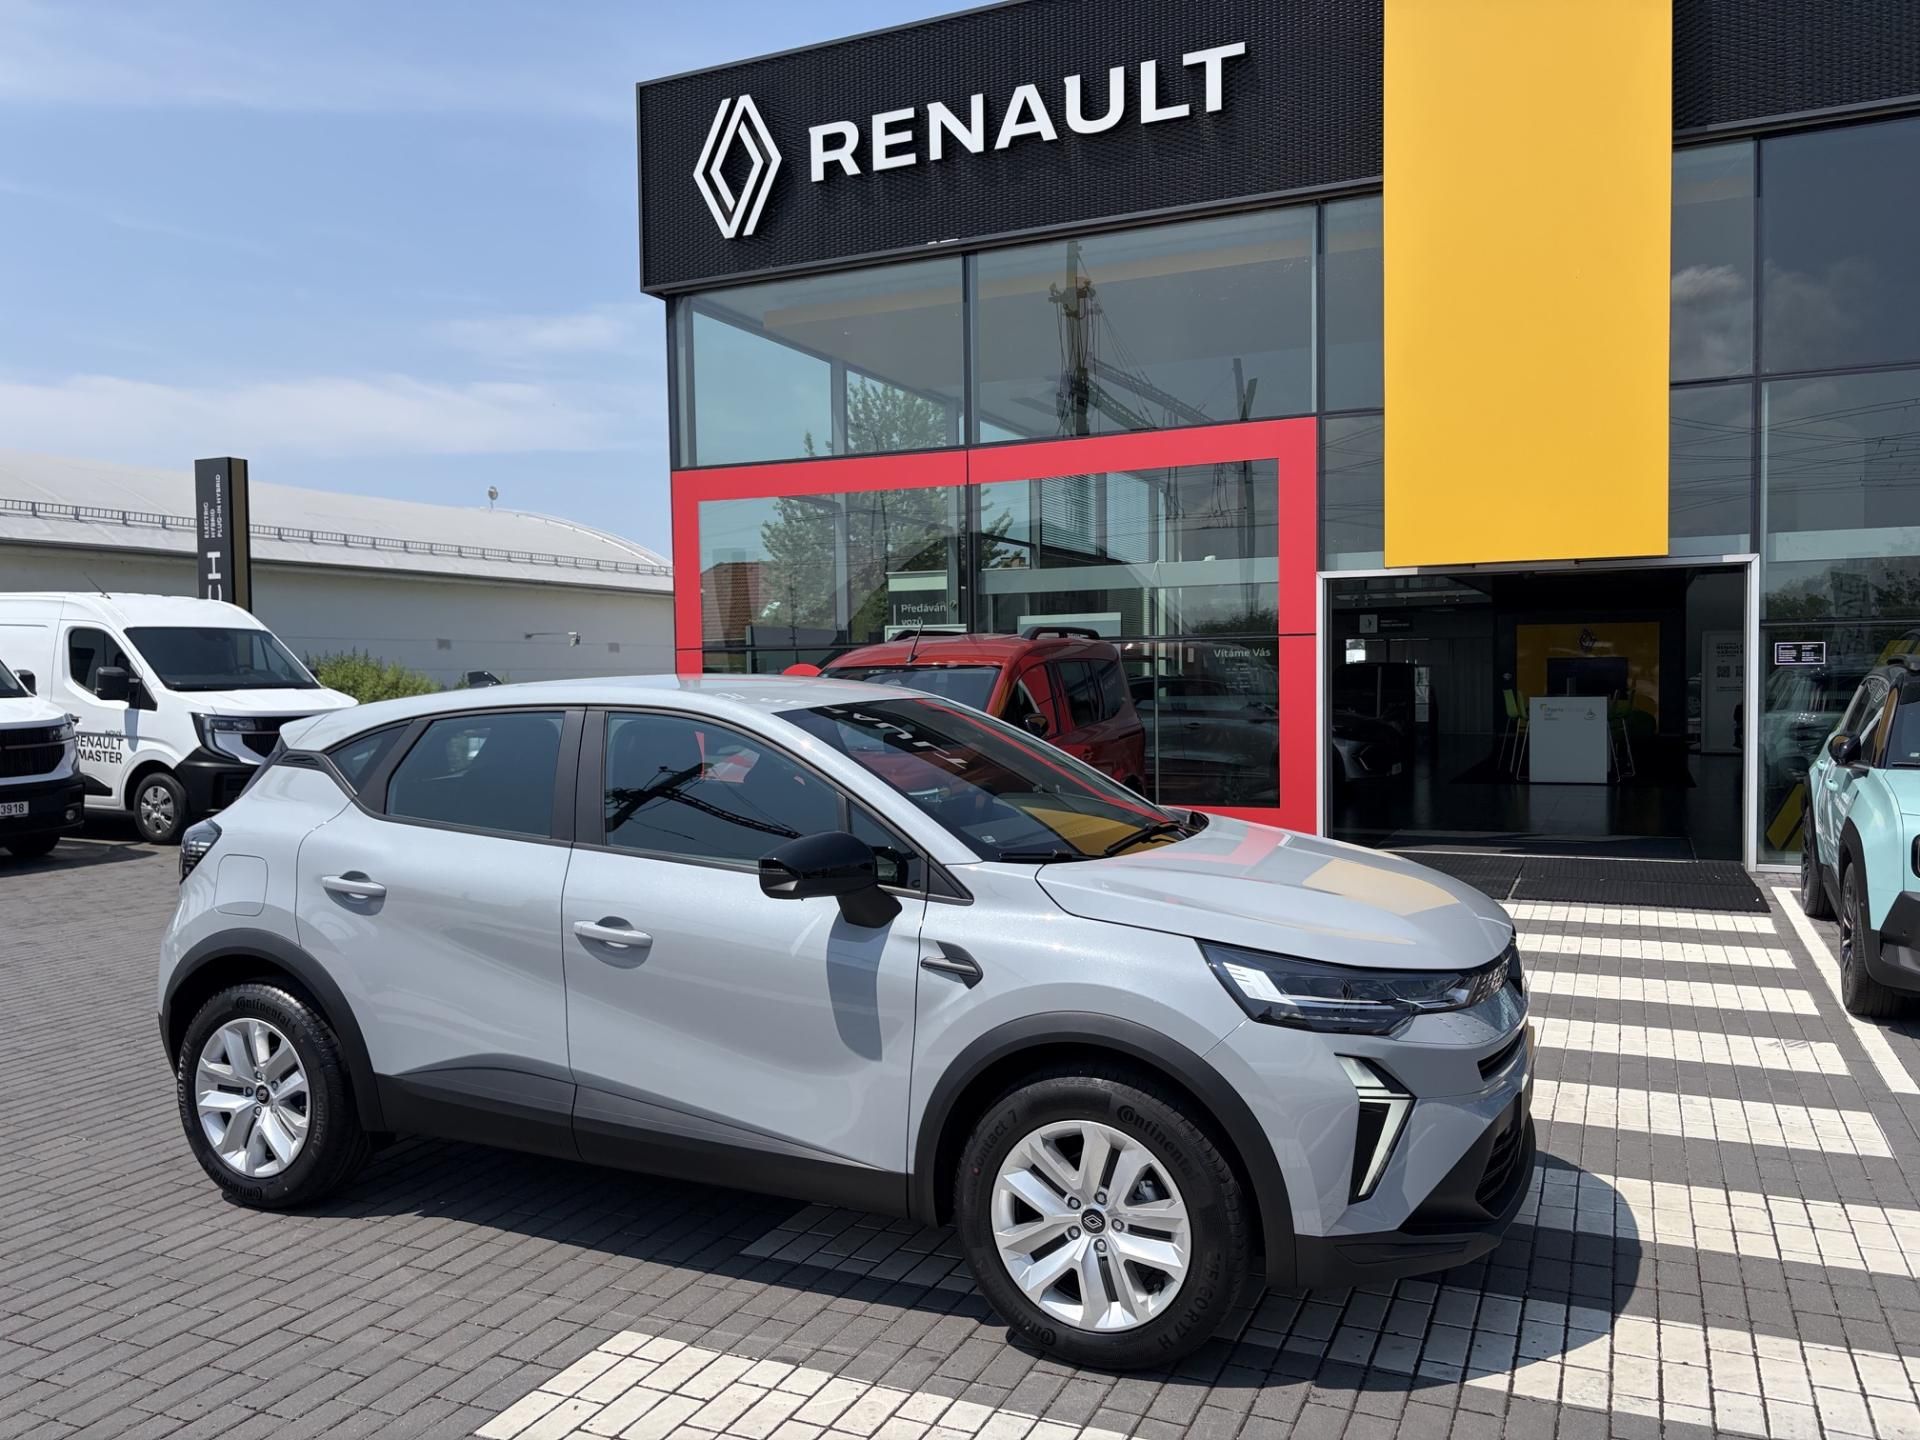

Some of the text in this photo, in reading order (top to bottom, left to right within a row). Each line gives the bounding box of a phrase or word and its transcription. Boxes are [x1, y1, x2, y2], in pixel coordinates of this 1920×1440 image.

[809, 42, 1245, 182] RENAULT
[901, 601, 947, 613] Předáván
[1213, 648, 1271, 658] Vítáme Vás
[78, 748, 123, 764] MASTER
[1, 803, 24, 815] 3918
[236, 996, 291, 1028] Continental
